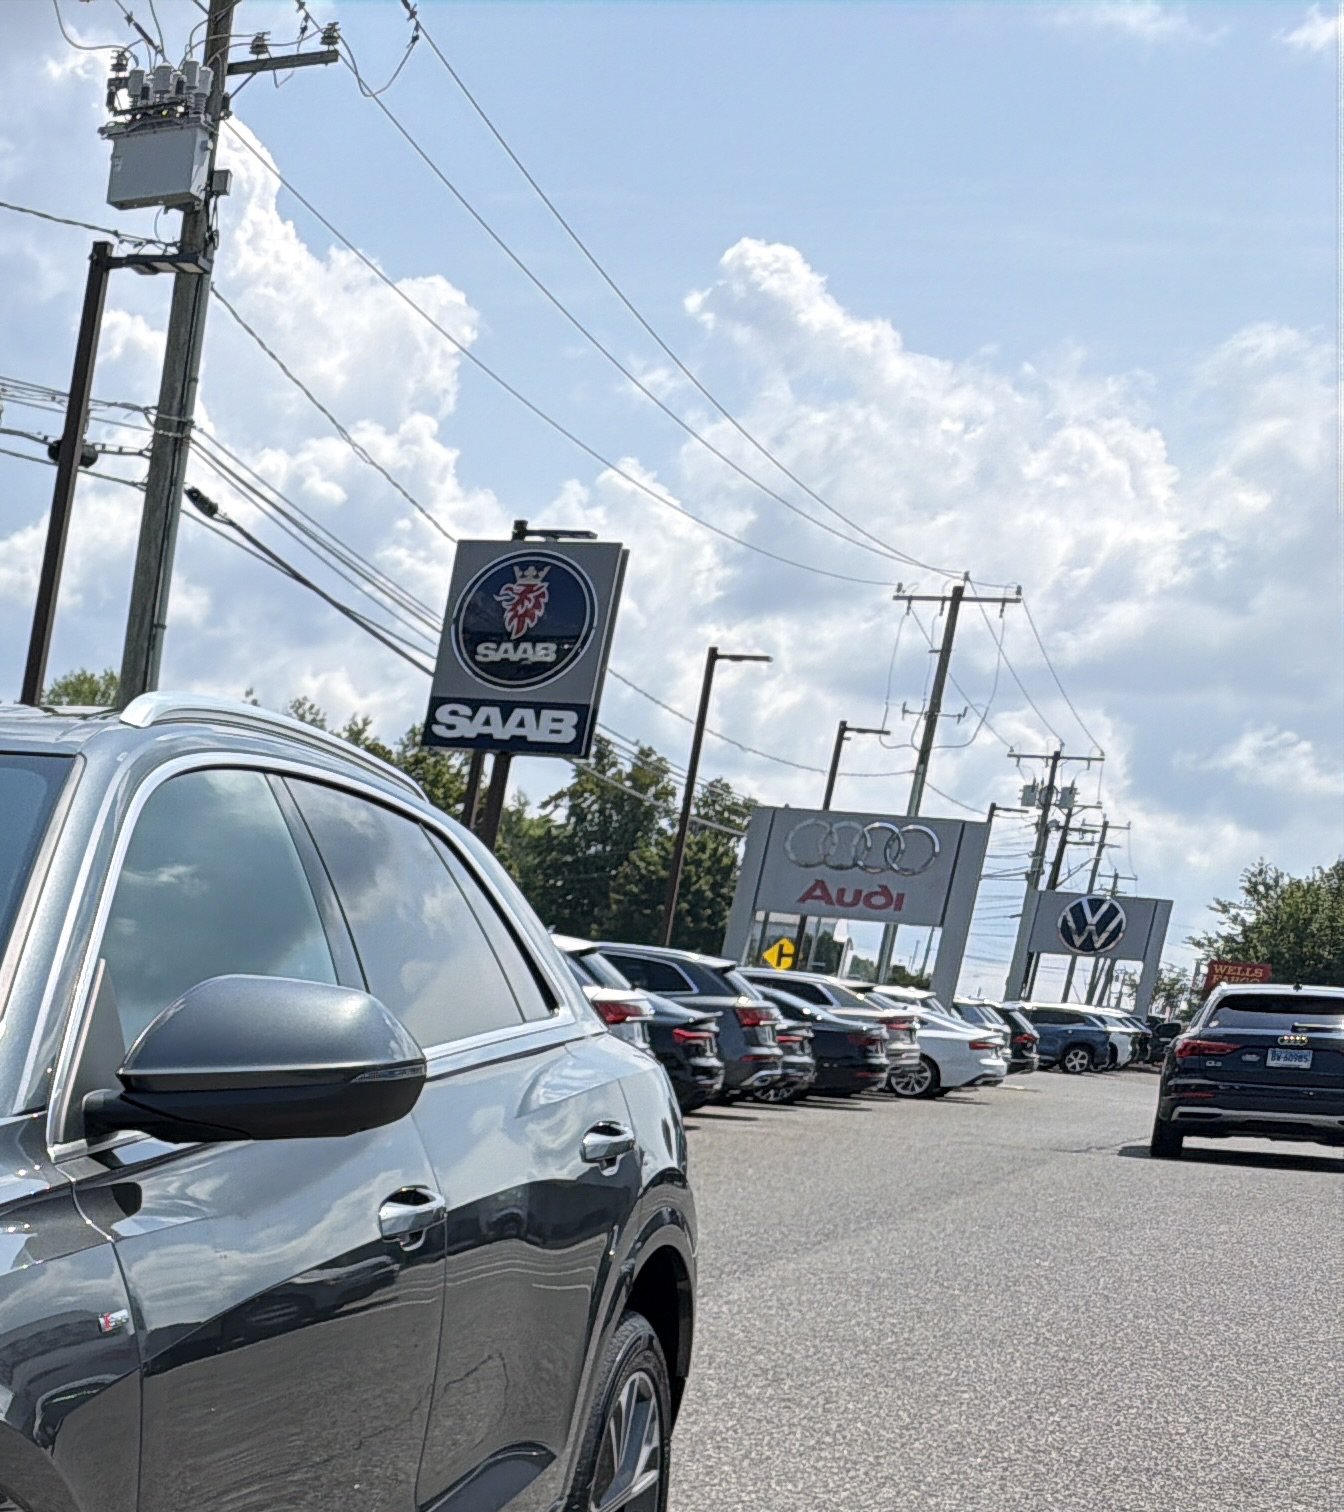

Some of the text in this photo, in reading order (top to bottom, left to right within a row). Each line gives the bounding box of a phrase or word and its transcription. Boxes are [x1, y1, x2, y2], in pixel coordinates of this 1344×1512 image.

[475, 641, 558, 664] SAAB
[431, 703, 579, 744] SAAB
[795, 879, 905, 912] Audi
[1213, 964, 1264, 978] WELLS
